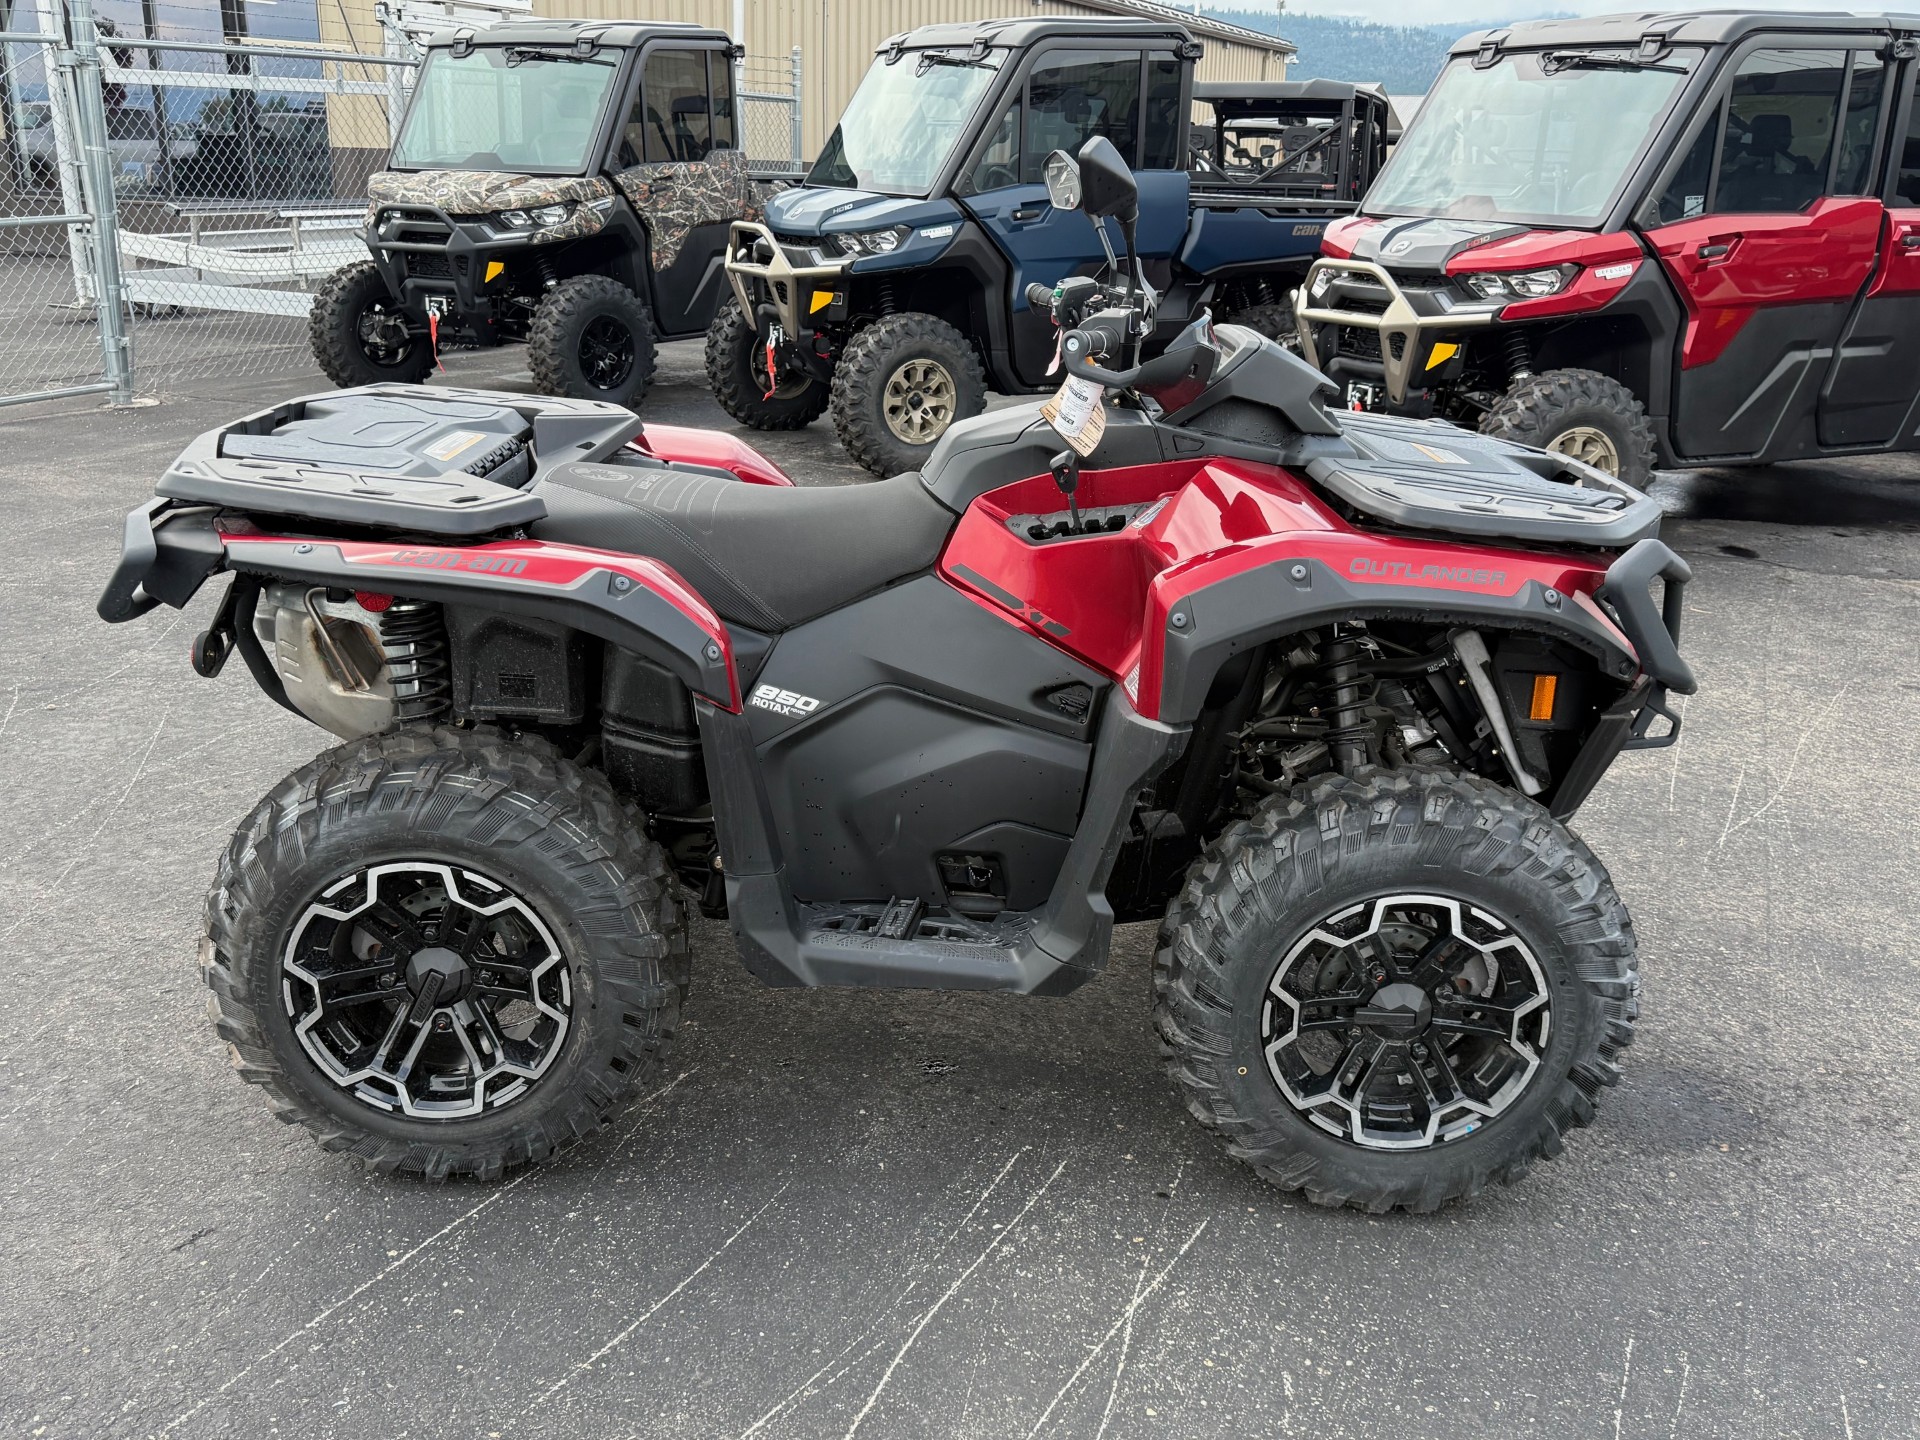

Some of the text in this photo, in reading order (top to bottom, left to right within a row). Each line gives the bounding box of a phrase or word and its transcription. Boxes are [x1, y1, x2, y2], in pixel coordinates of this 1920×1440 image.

[832, 203, 853, 214] HD10
[1292, 224, 1324, 236] can-
[1466, 235, 1490, 249] HD10
[392, 549, 528, 575] can-am
[1350, 557, 1507, 586] OUTLANDER
[751, 696, 807, 716] ROTAX POWER
[755, 684, 820, 712] 850
